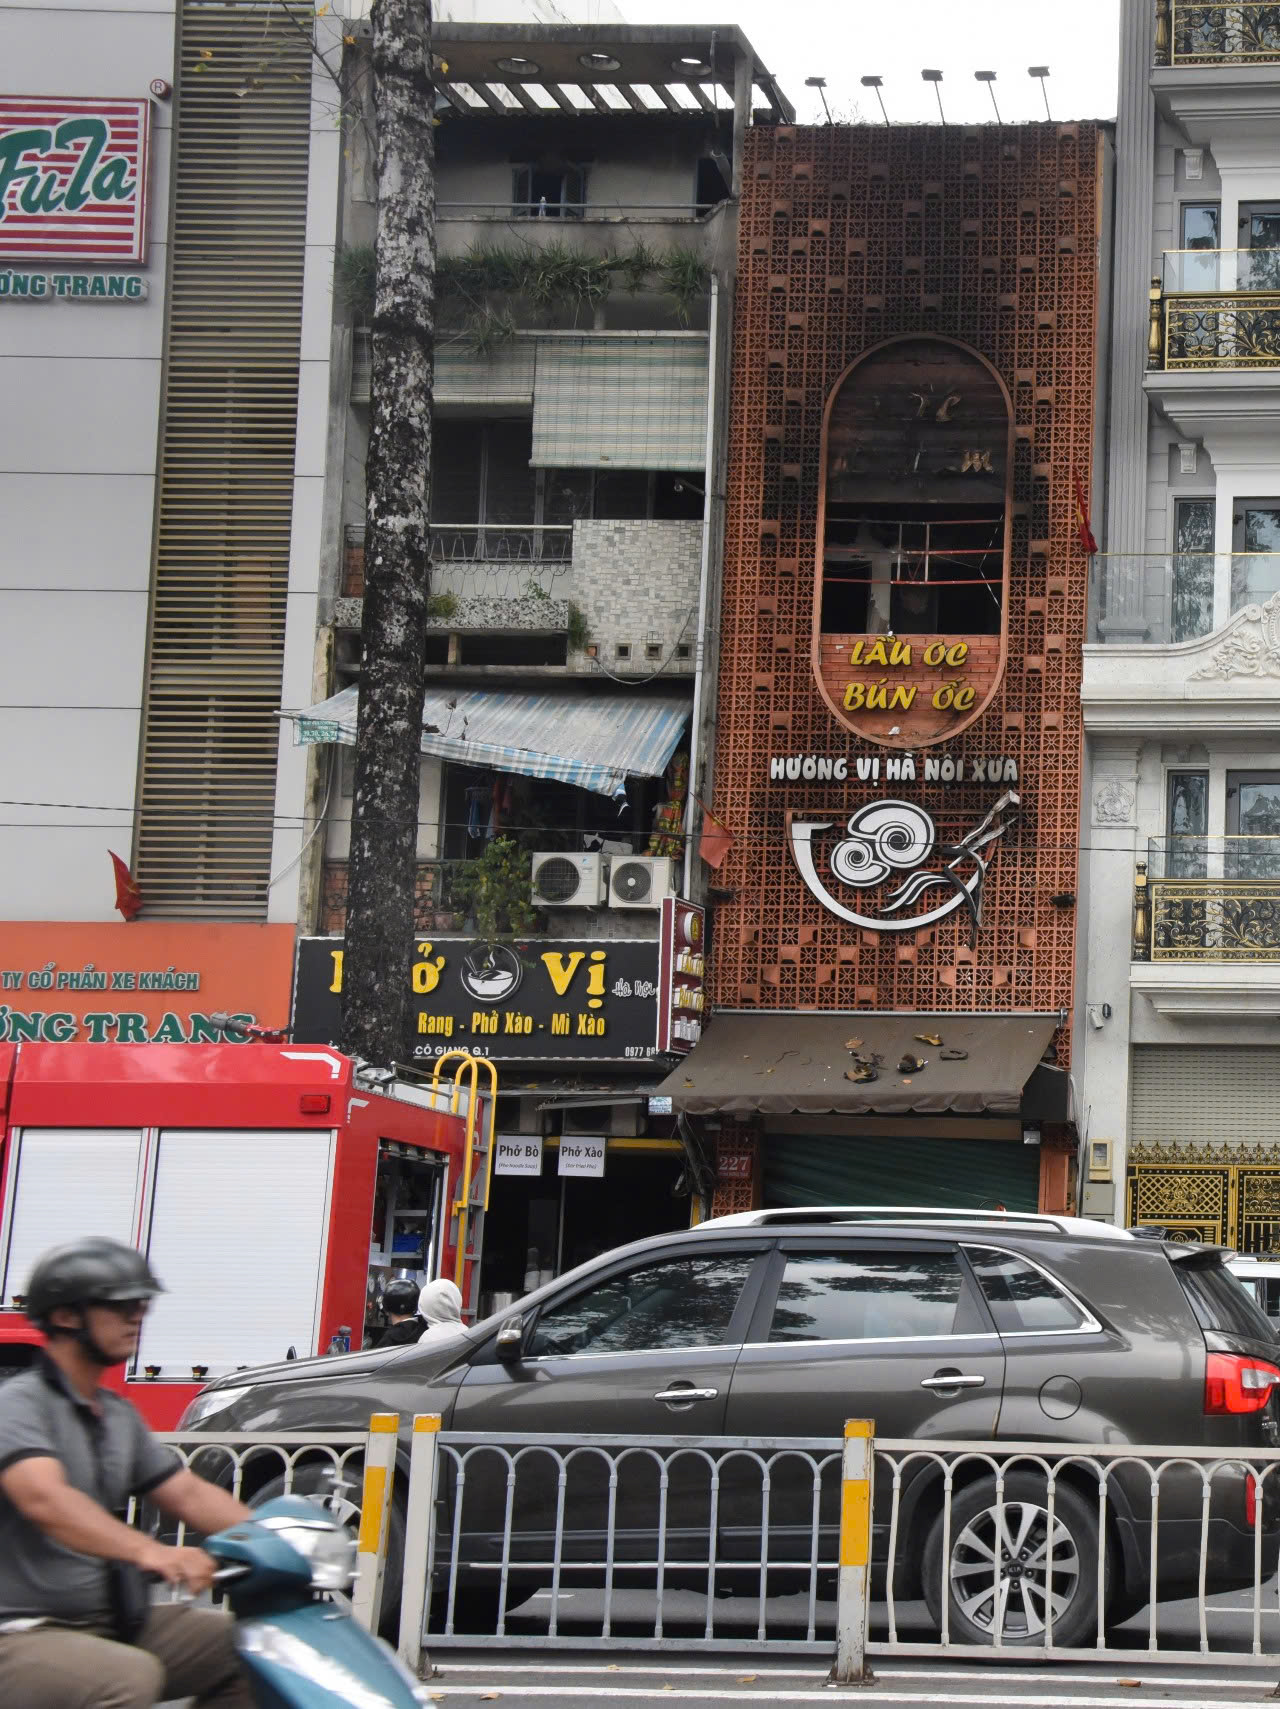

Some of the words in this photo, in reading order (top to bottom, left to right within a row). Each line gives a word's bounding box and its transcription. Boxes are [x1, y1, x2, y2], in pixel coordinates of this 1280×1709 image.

[51, 275, 142, 297] TRANG
[843, 678, 918, 712] BÚN
[931, 676, 977, 711] ỐC
[770, 753, 848, 780] HƯƠNG
[856, 757, 880, 787] VỊ
[886, 752, 916, 781] HÀ
[971, 755, 1018, 782] XƯA
[1, 970, 24, 989] TY
[28, 961, 56, 989] CỔ
[110, 971, 136, 990] XE
[138, 966, 200, 991] KHÁCH
[540, 950, 606, 1009] Vị
[0, 1004, 78, 1043] NG
[418, 1011, 454, 1037] Rang
[471, 1010, 499, 1034] Phở
[504, 1011, 533, 1034] Xào
[551, 1013, 571, 1035] Mì
[576, 1013, 606, 1036] Xào
[472, 1046, 489, 1056] Q.1
[625, 1046, 644, 1057] 0977
[646, 1046, 658, 1057] 68
[499, 1144, 521, 1157] Phở
[525, 1144, 539, 1158] Bò
[561, 1145, 582, 1158] Phở
[584, 1145, 603, 1158] Xào
[719, 1156, 749, 1171] 227
